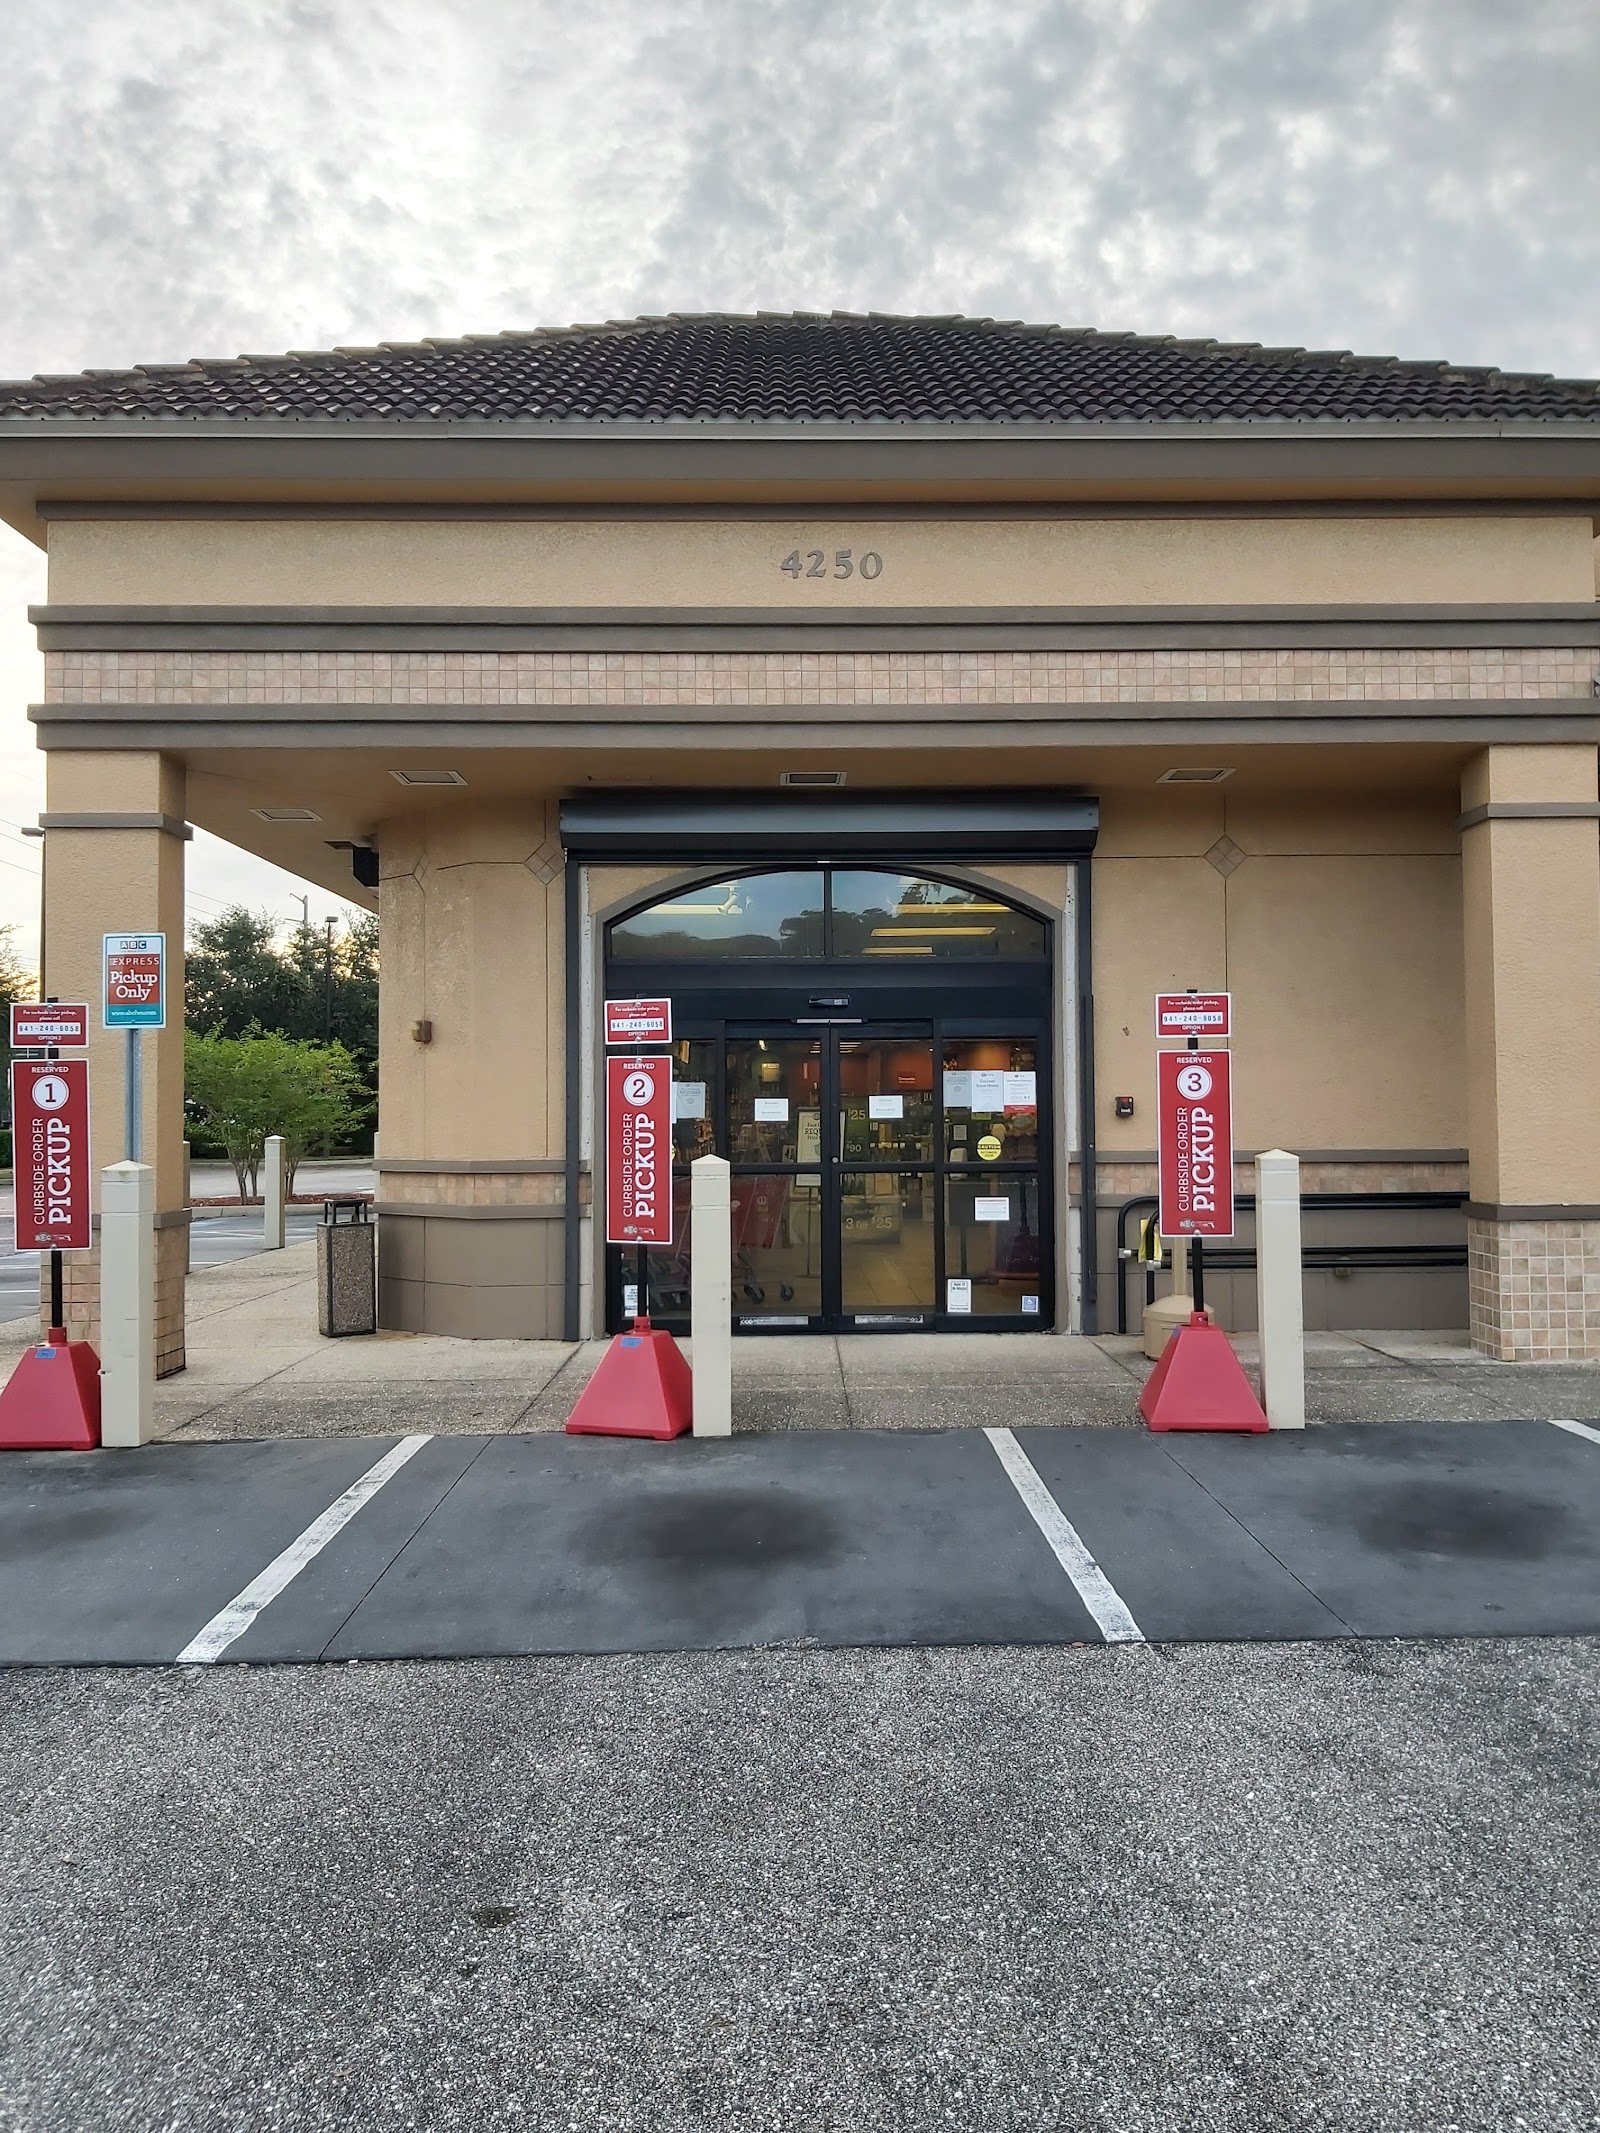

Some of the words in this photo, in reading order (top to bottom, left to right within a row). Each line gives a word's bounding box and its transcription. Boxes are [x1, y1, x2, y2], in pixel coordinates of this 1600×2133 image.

[780, 549, 883, 580] 4250
[120, 940, 147, 950] ABC
[111, 957, 160, 966] EXPRESS
[109, 969, 158, 987] Pickup
[115, 984, 152, 1001] Only
[612, 1020, 663, 1029] 941-240-6058
[1176, 1056, 1212, 1064] RESERVED
[44, 1083, 57, 1103] 1
[632, 1078, 646, 1098] 2
[1187, 1072, 1202, 1092] 3
[32, 1118, 44, 1162] ORDER
[623, 1113, 633, 1155] ORDER
[1177, 1107, 1188, 1150] ORDER
[47, 1117, 72, 1225] PICKUP
[635, 1113, 655, 1218] PICKUP
[1191, 1107, 1215, 1212] PICKUP
[33, 1164, 45, 1225] CURBSIDE
[623, 1158, 633, 1218] CURBSIDE
[1178, 1152, 1189, 1212] CURBSIDE
